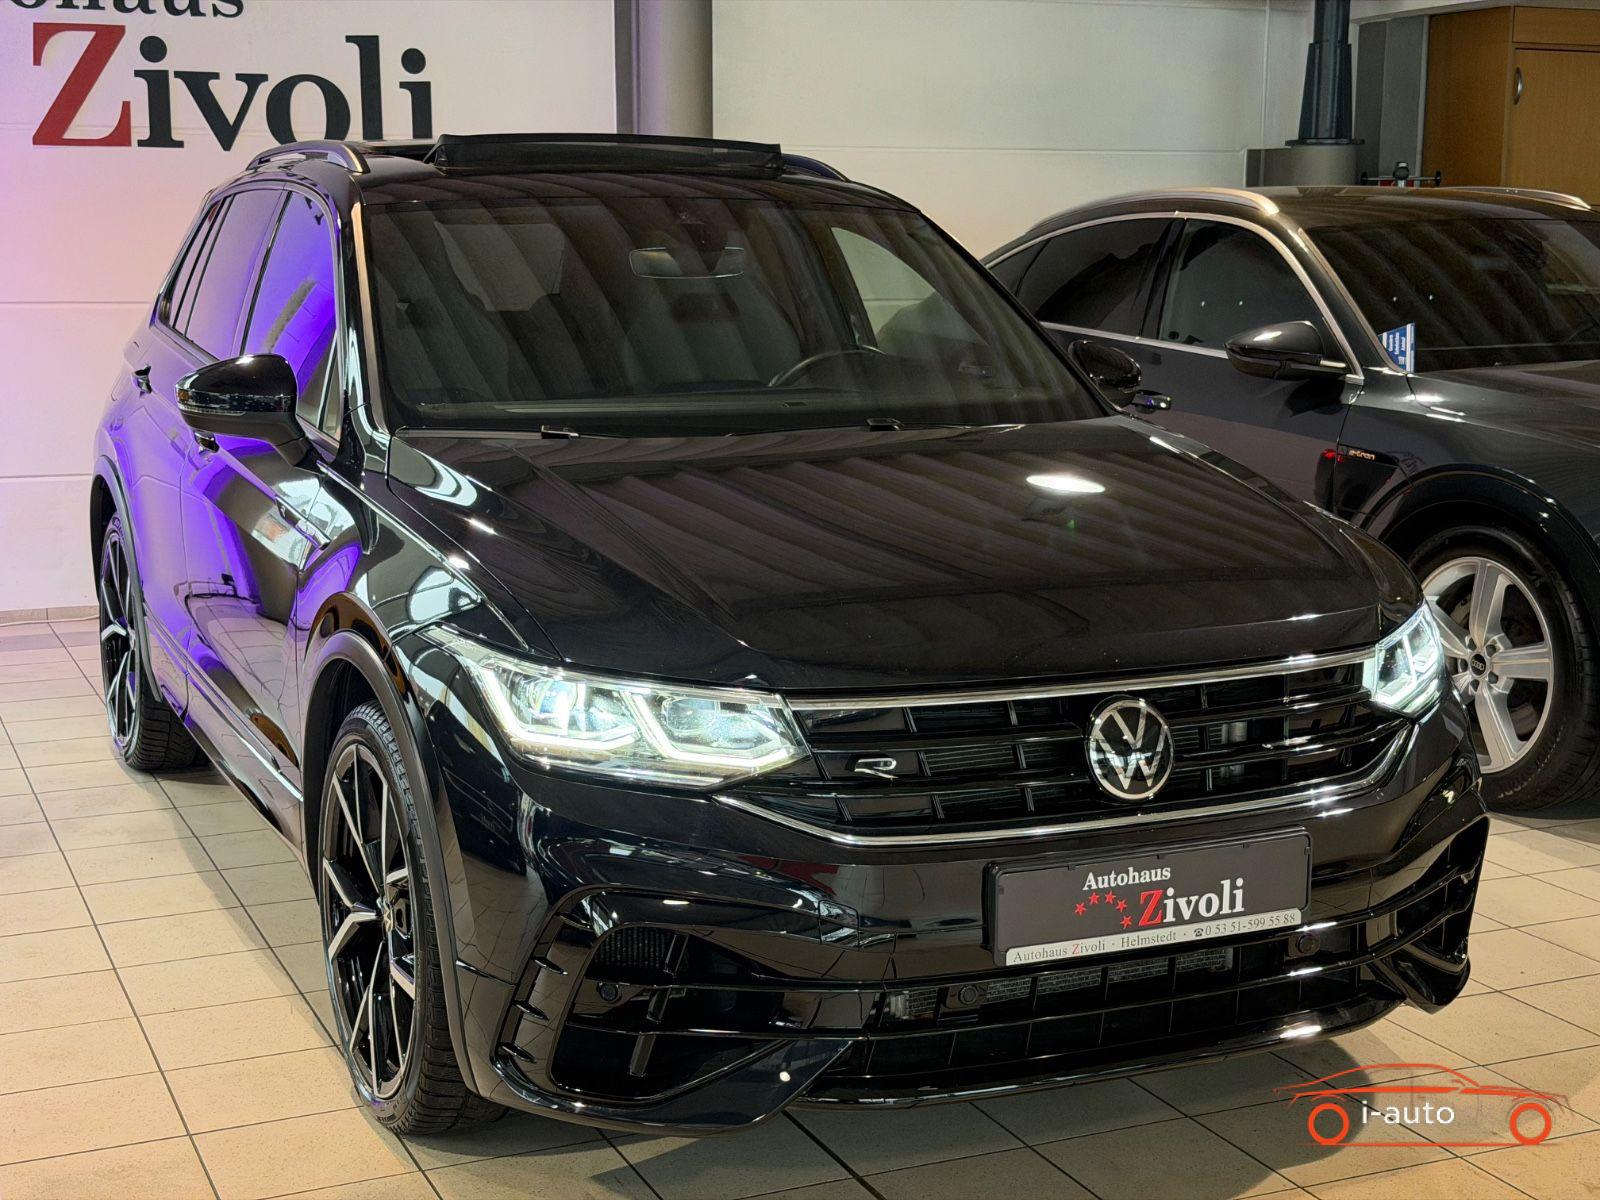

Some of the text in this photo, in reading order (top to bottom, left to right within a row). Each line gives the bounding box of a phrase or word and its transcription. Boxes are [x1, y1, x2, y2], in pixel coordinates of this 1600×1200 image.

[33, 22, 433, 151] Zivoli
[1082, 866, 1171, 890] Autohaus
[1138, 877, 1245, 926] Zivoli
[1013, 947, 1067, 962] Autohaus
[1071, 940, 1105, 955] Zivoli
[1121, 930, 1176, 948] Helmstedt
